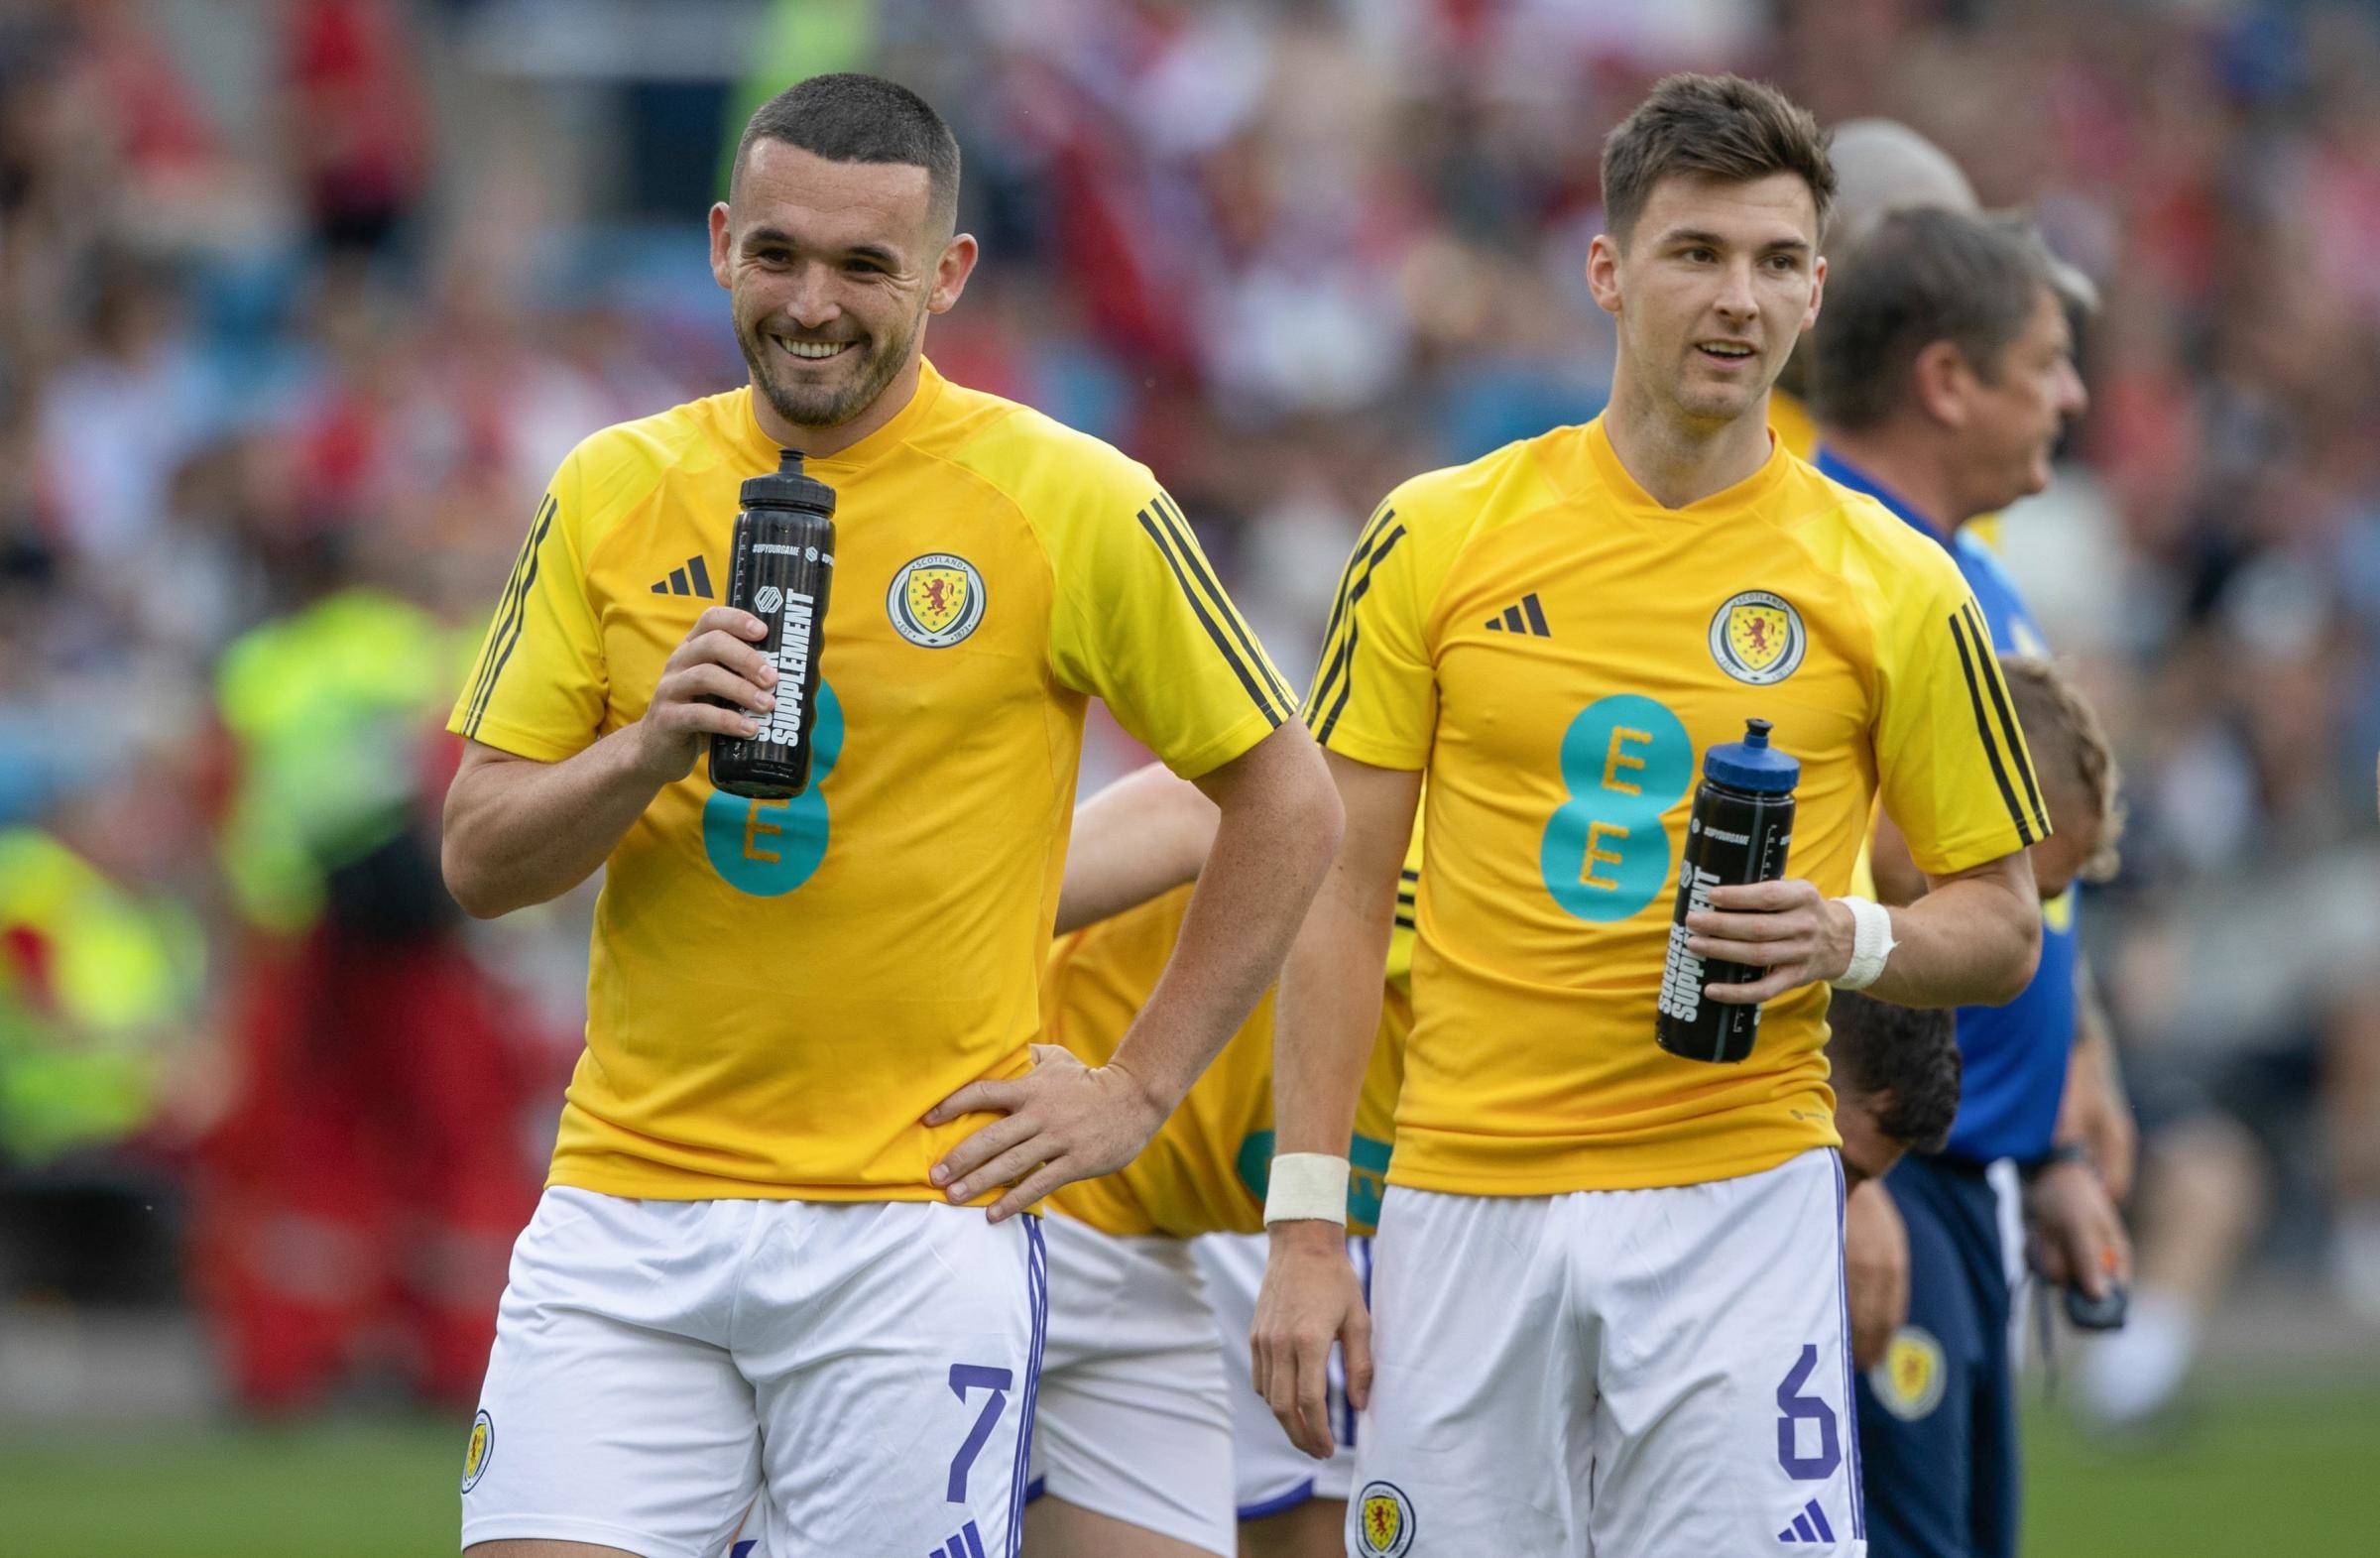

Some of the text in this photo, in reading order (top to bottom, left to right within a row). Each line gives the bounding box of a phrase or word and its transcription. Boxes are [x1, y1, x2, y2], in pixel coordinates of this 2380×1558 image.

[915, 556, 963, 568] SCOTLAND
[771, 588, 814, 748] SUPPLEMENT
[898, 625, 912, 636] EST
[954, 626, 970, 640] 1873
[946, 1364, 1013, 1503] 7
[1776, 1344, 1843, 1481] 6
